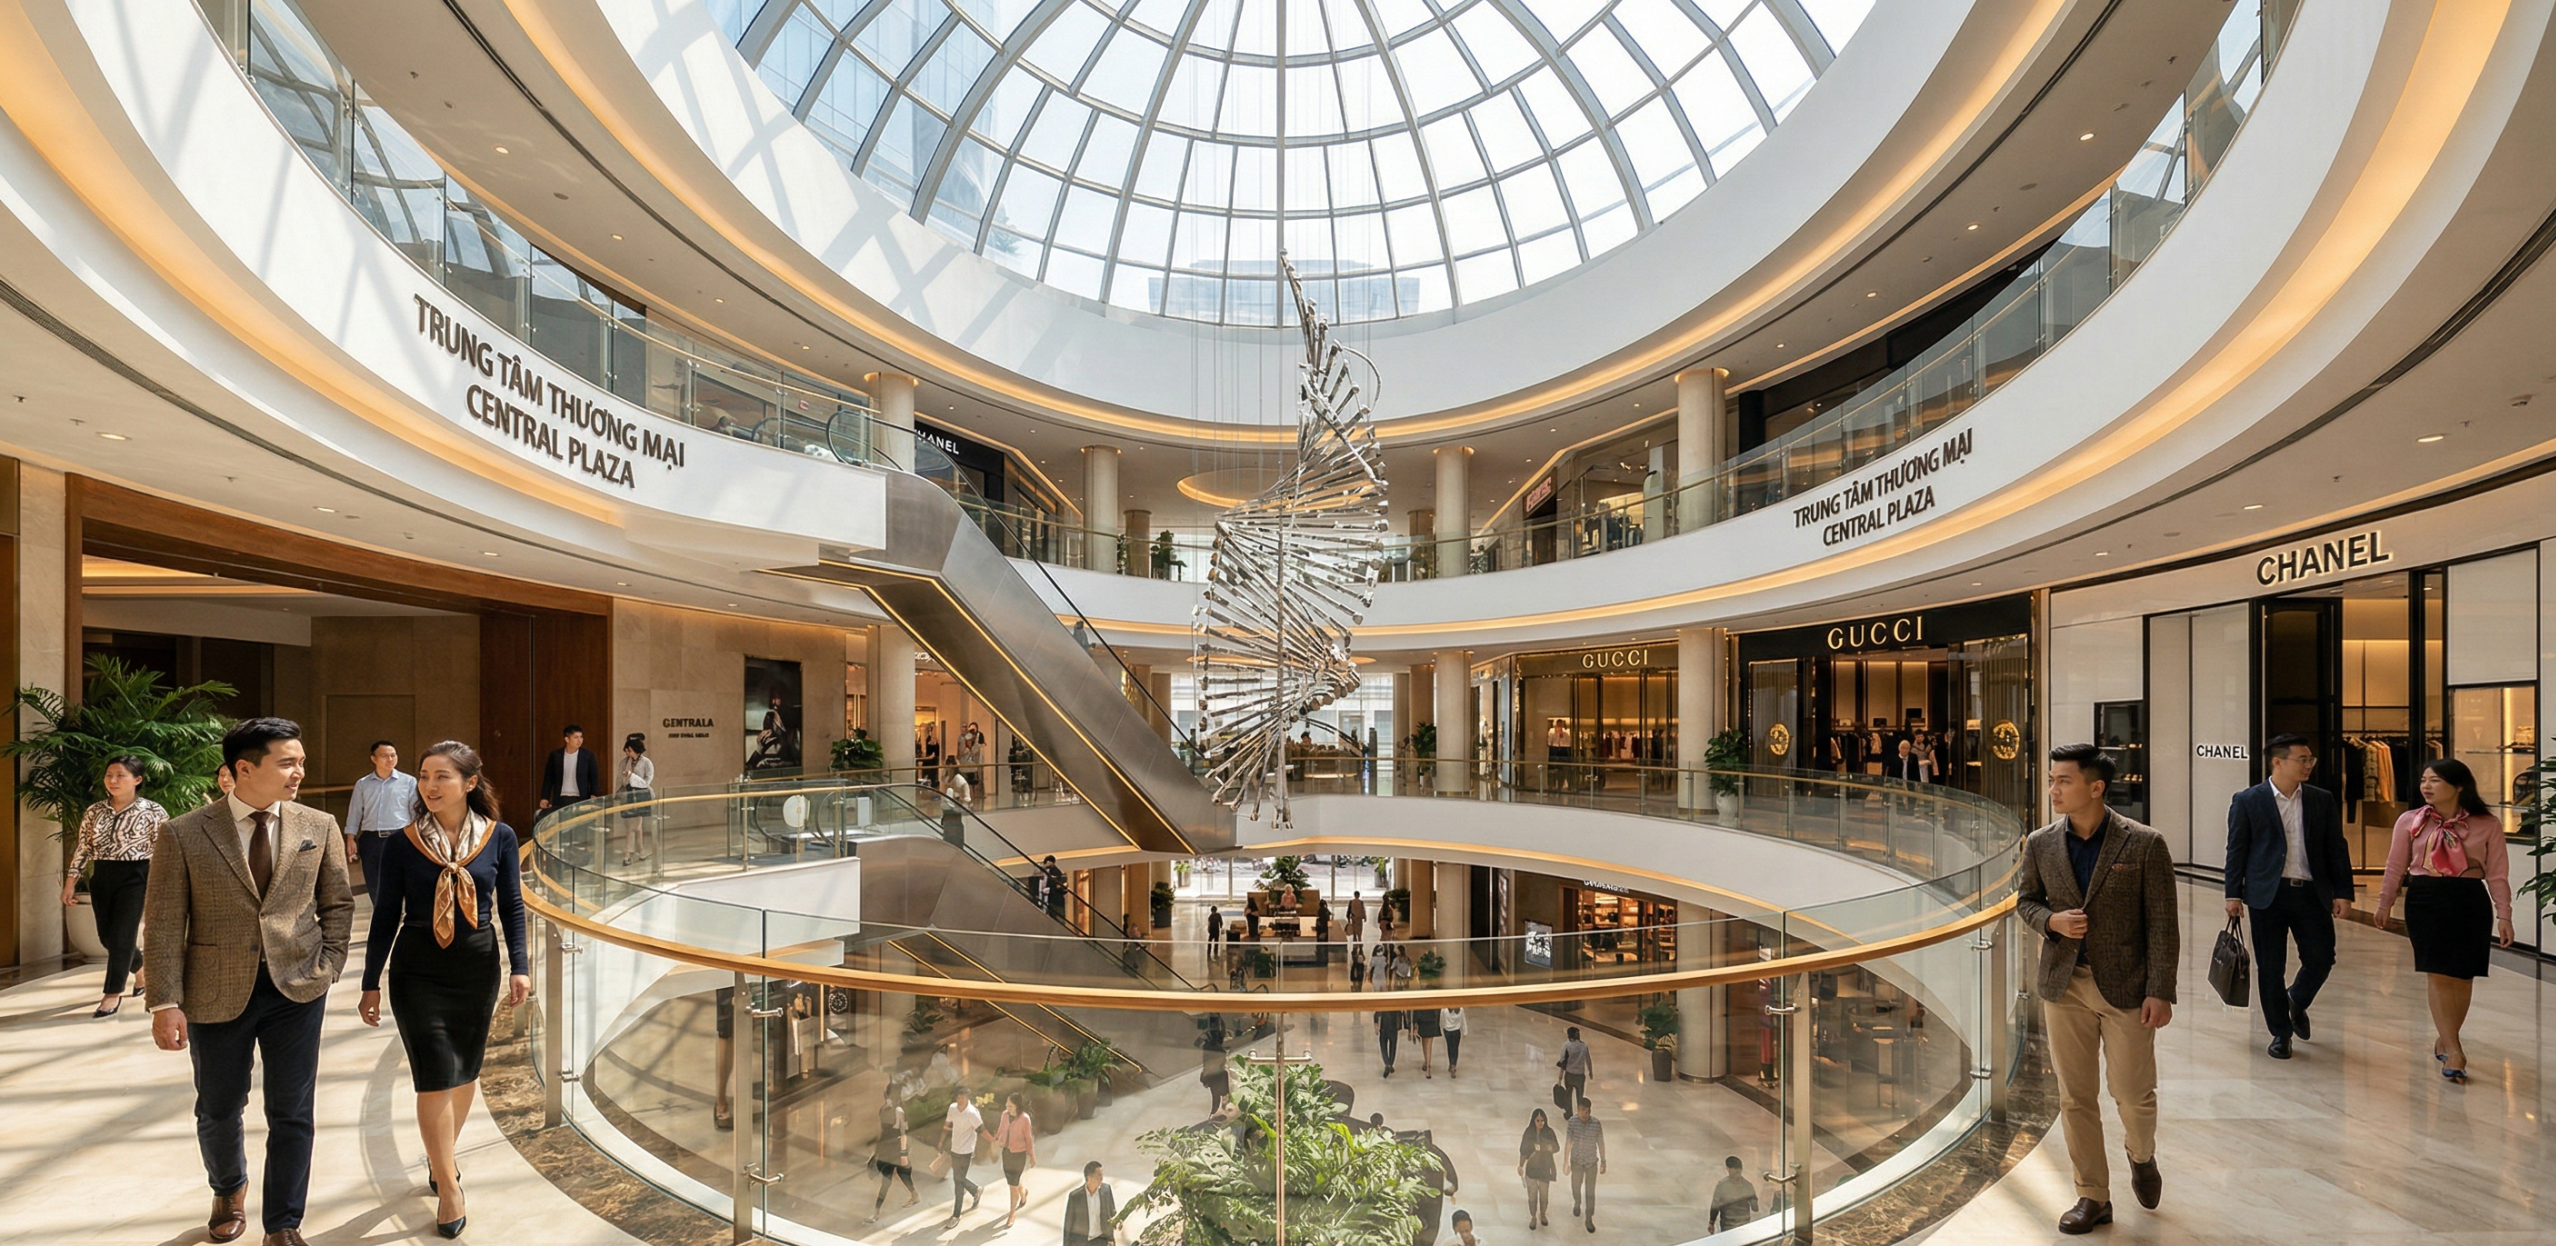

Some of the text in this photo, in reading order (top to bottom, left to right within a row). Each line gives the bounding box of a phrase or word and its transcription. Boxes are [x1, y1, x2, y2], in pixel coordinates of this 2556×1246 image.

[414, 293, 685, 470] TRUNG TÂM THƯƠNG MẠI
[466, 384, 635, 489] CENTRAL PLAZA
[914, 429, 959, 455] HANEL
[1793, 427, 1973, 528] TRUNG TÂM THƯƠNG MẠI
[1823, 485, 1935, 546] CENTRAL PLAZA
[2256, 531, 2391, 586] CHANEL
[1582, 649, 1648, 669] GUCCI
[1827, 615, 1923, 650] GUCCI
[2196, 744, 2249, 760] CHANEL
